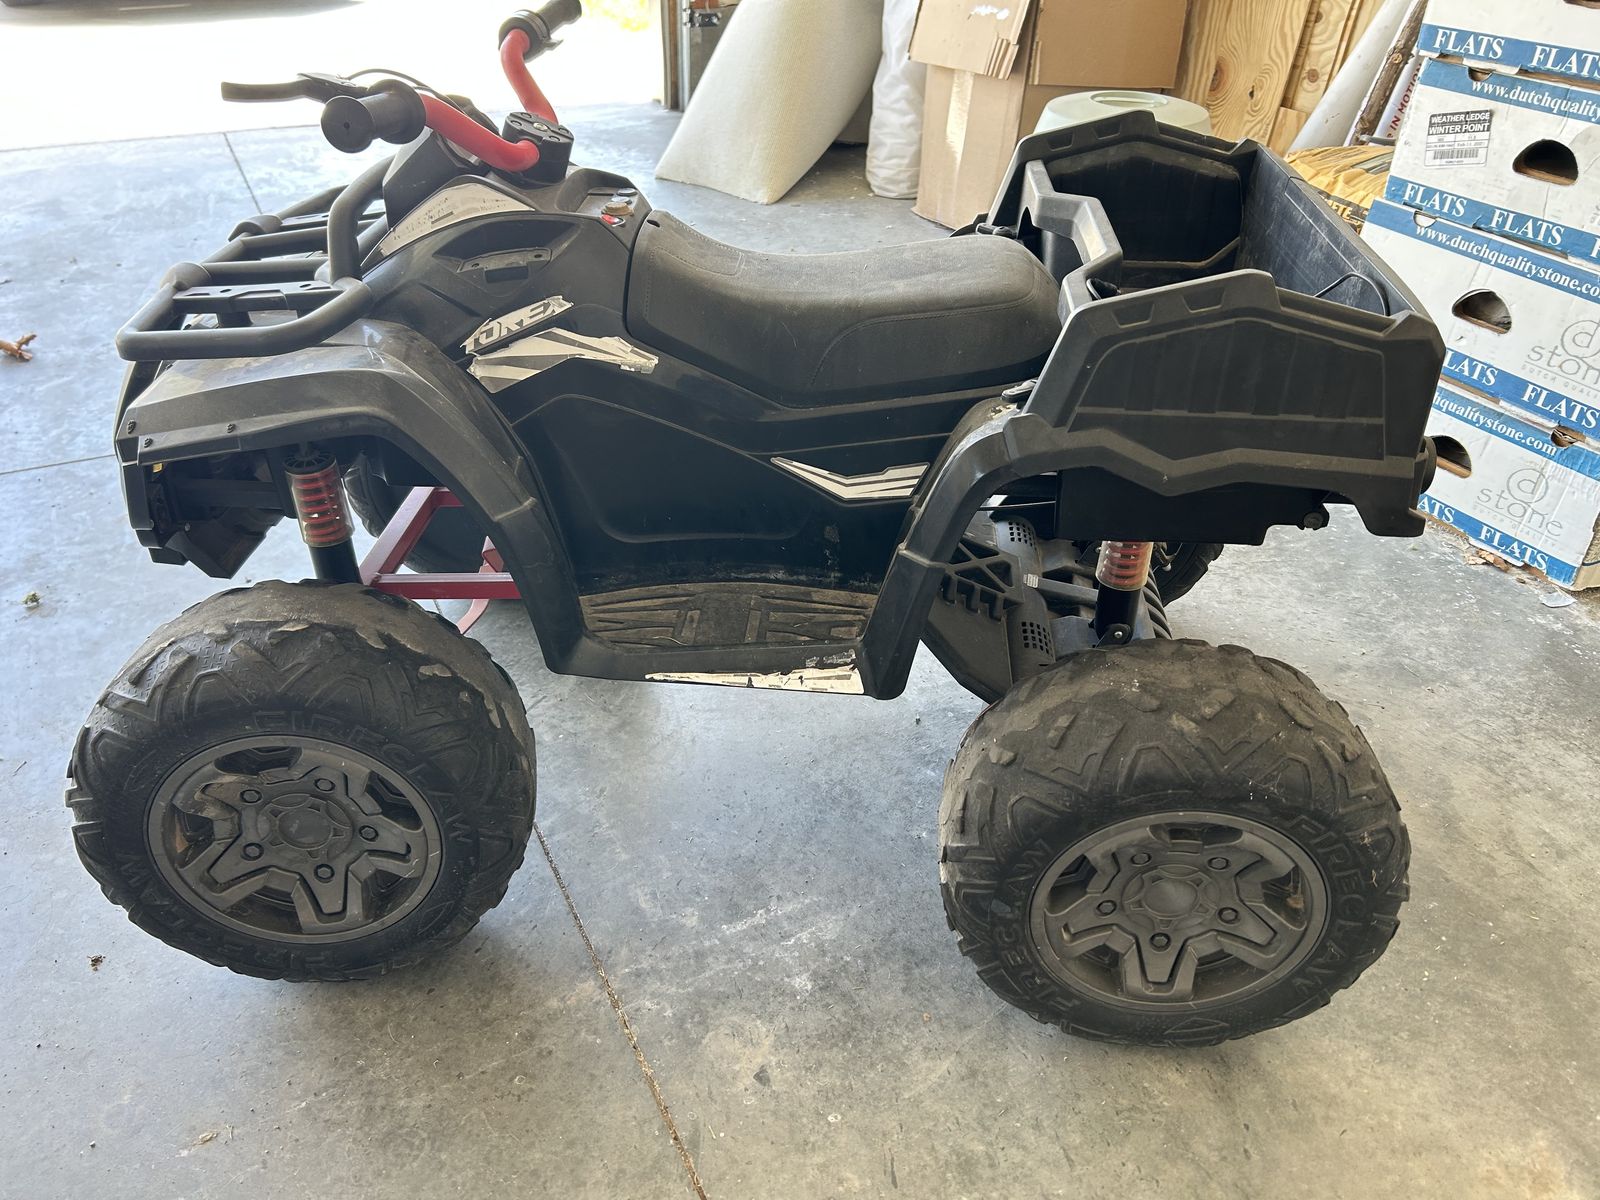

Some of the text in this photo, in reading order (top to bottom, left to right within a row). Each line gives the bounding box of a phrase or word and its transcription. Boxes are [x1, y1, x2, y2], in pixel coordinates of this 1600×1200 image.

[1433, 28, 1505, 60] FLATS
[1390, 114, 1402, 131] IN
[1429, 123, 1489, 134] WINTER POINT
[1431, 112, 1490, 123] WEATHER LEDGE
[1403, 183, 1467, 217] FLATS
[1489, 208, 1565, 246] FLATS
[1416, 225, 1600, 298] www.dutchqualitystone.co
[1442, 350, 1498, 386] LATS
[1521, 382, 1600, 429] FLATS
[1417, 496, 1455, 524] ATS
[1477, 488, 1563, 537] stone
[1478, 524, 1549, 570] FLATS
